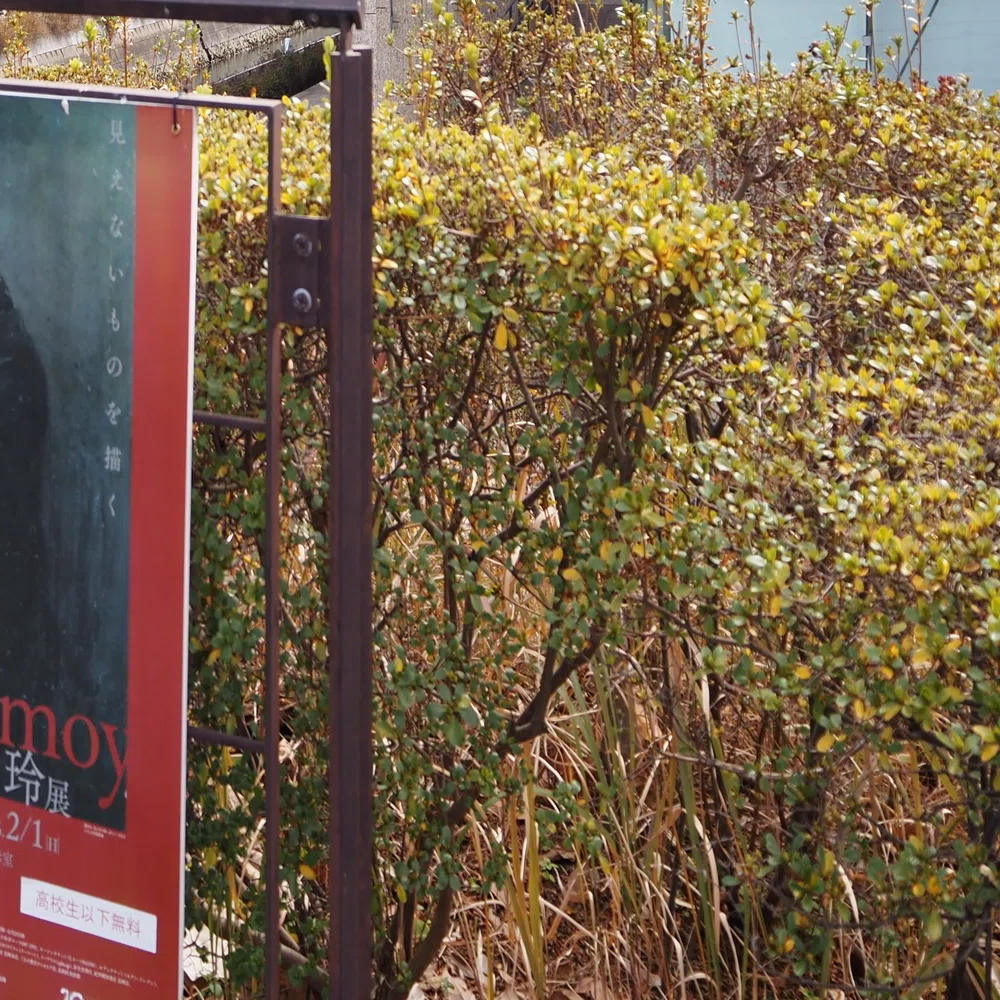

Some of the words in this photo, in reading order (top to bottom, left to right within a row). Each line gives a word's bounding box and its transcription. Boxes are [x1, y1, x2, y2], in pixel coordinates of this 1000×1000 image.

[103, 119, 126, 518] 見えないものを描く
[35, 889, 141, 938] 高校生以下無料
